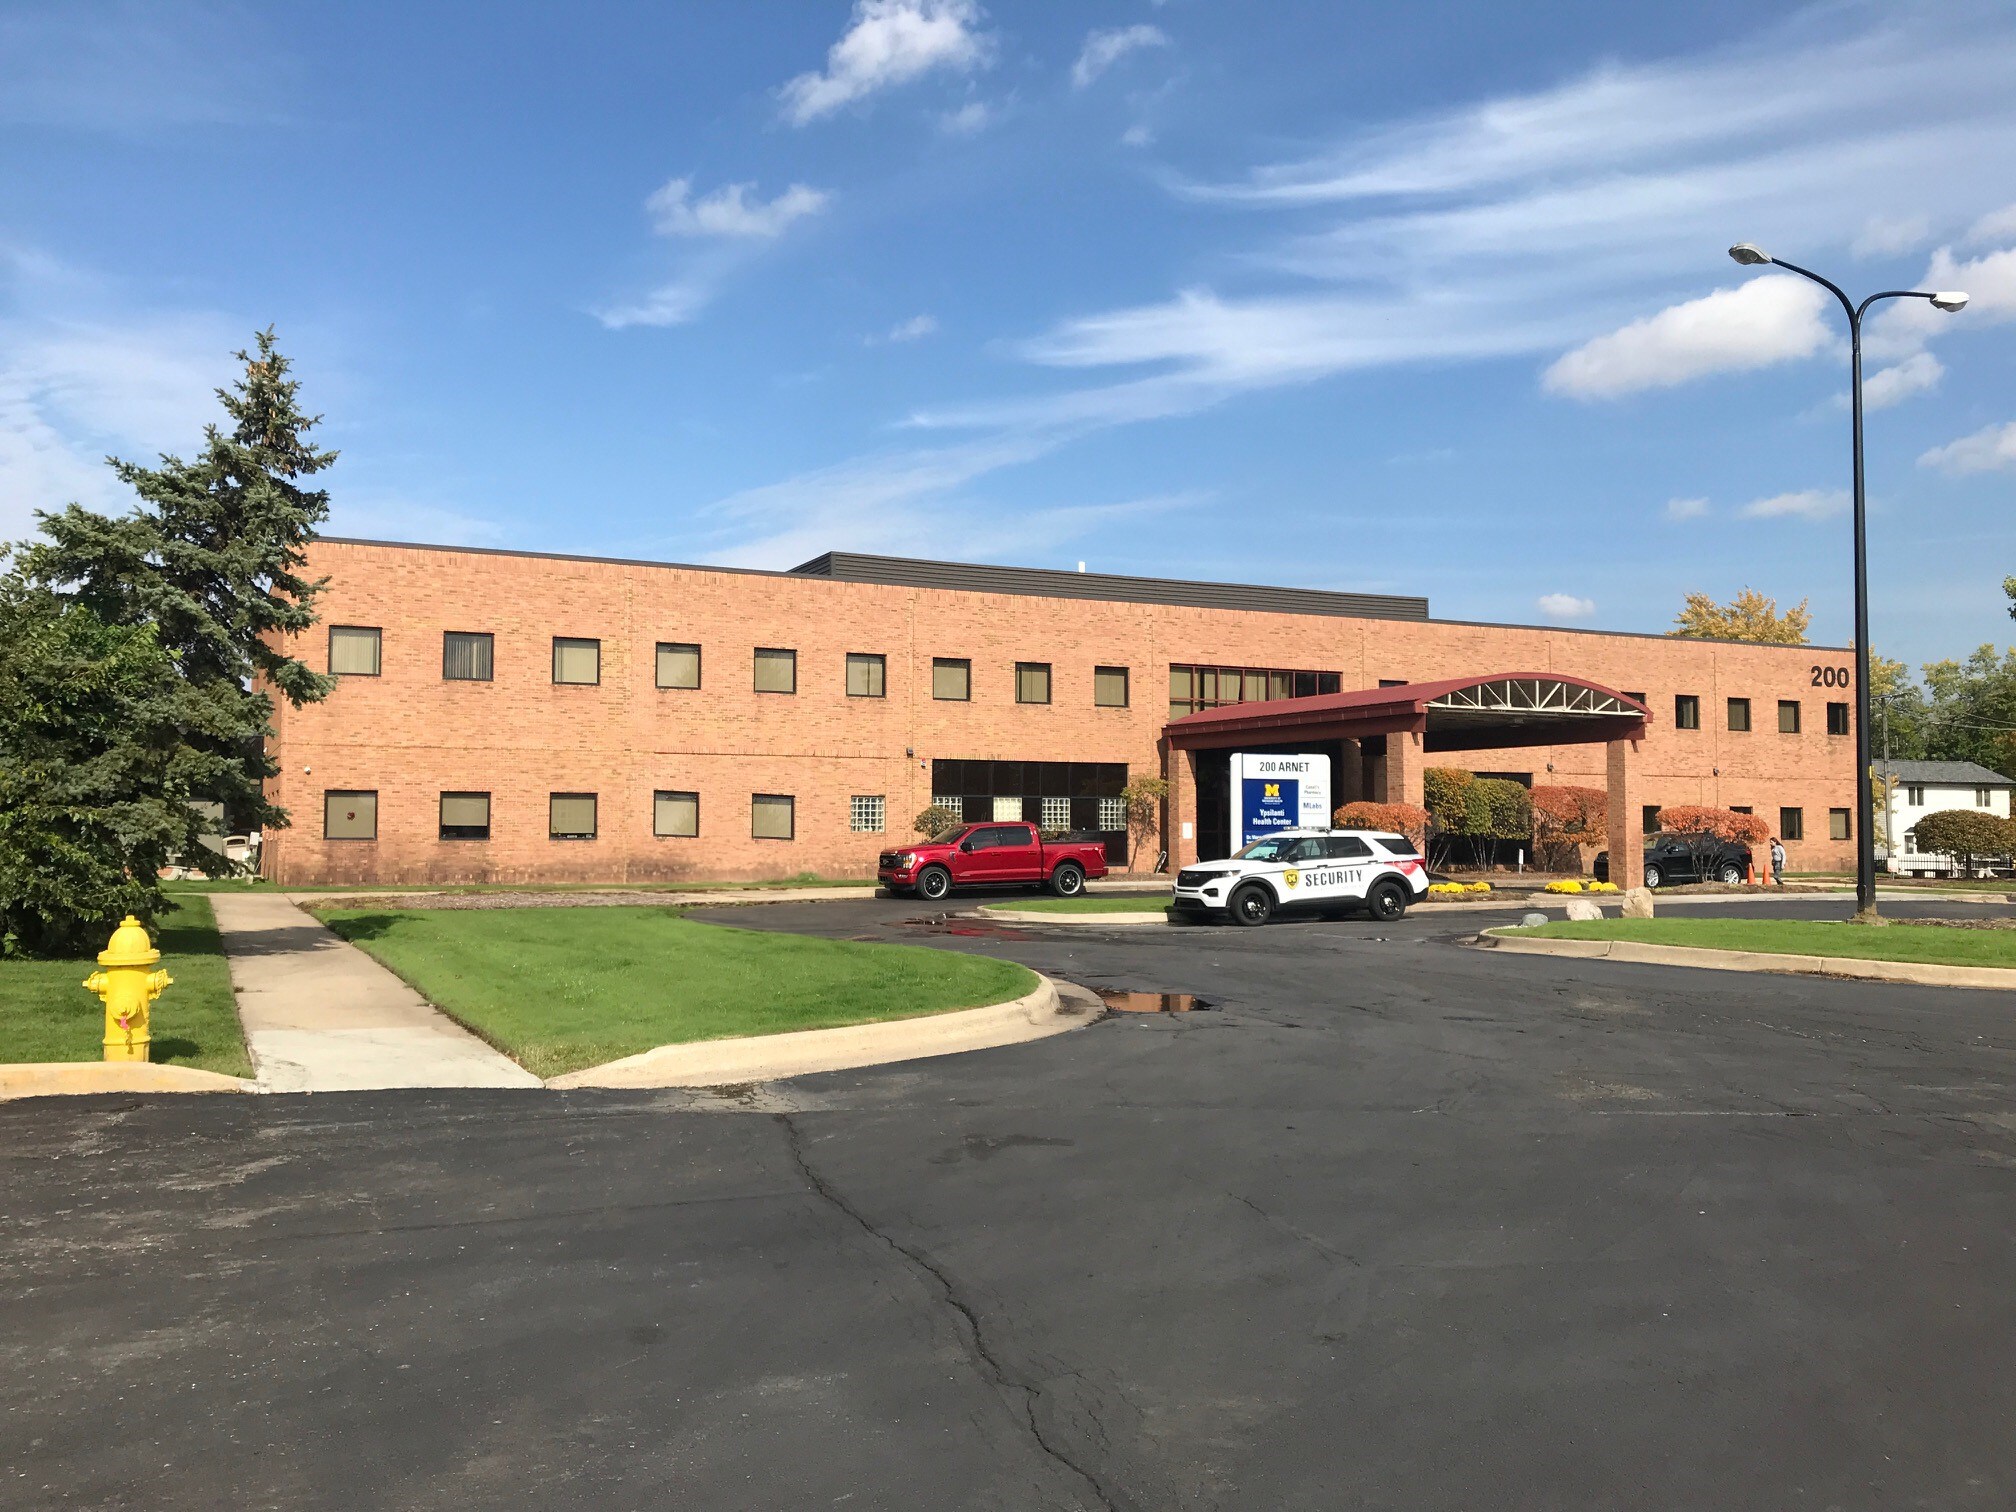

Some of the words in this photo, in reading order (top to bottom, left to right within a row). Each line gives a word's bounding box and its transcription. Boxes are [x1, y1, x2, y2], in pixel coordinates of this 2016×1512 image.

[1811, 665, 1850, 689] 200
[1259, 761, 1276, 772] 200
[1278, 762, 1310, 773] ARNET
[1265, 784, 1279, 796] M
[1260, 809, 1285, 818] Ypsilanti
[1252, 817, 1272, 826] Health
[1272, 817, 1292, 826] Center
[1305, 870, 1362, 887] SECURITY
